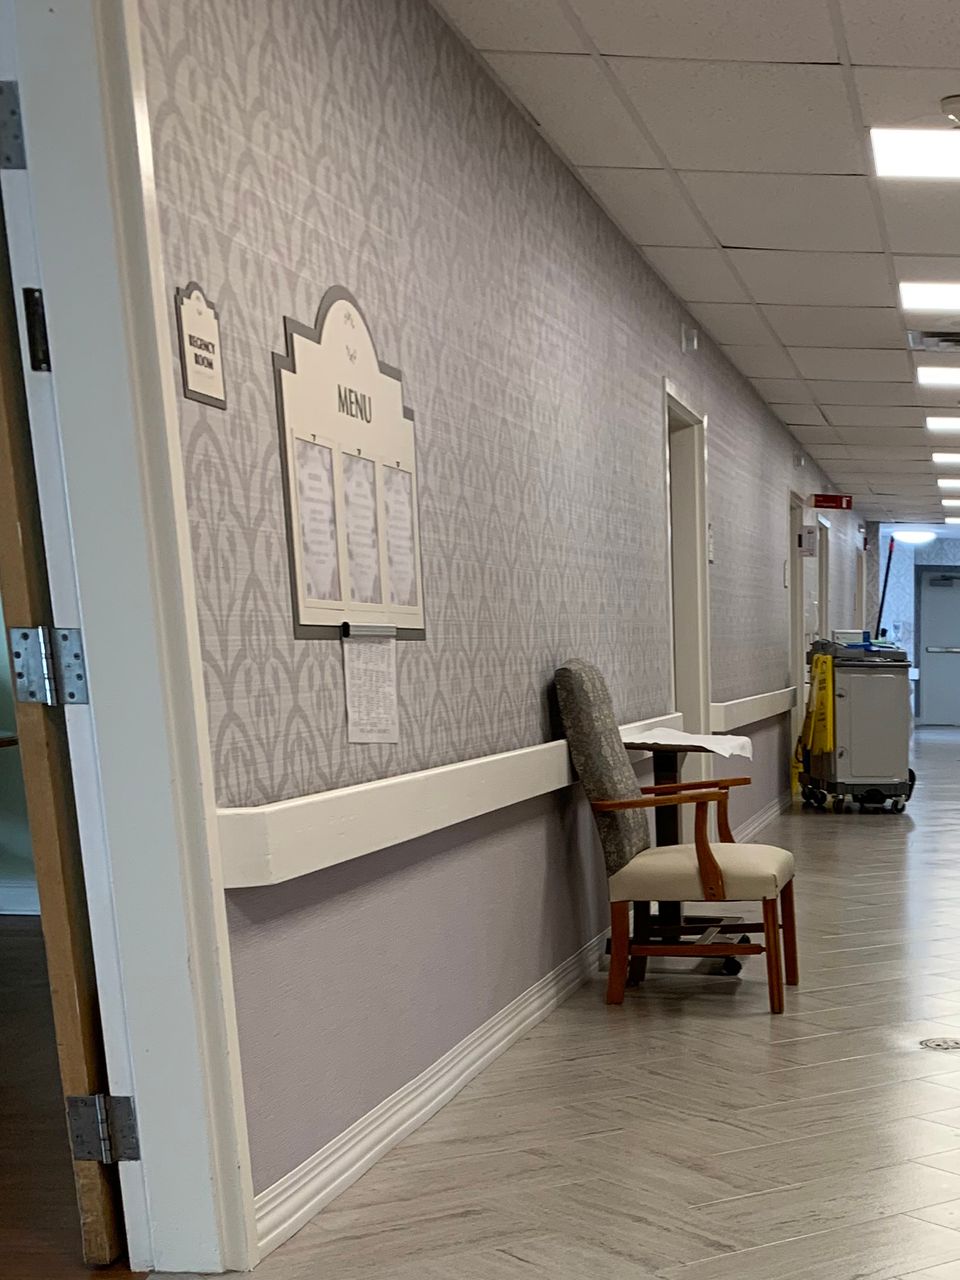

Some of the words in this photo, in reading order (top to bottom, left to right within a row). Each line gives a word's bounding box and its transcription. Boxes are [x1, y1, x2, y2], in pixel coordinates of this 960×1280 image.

[188, 334, 215, 355] REGENCY
[194, 352, 214, 370] ROOM
[337, 383, 372, 424] MENU
